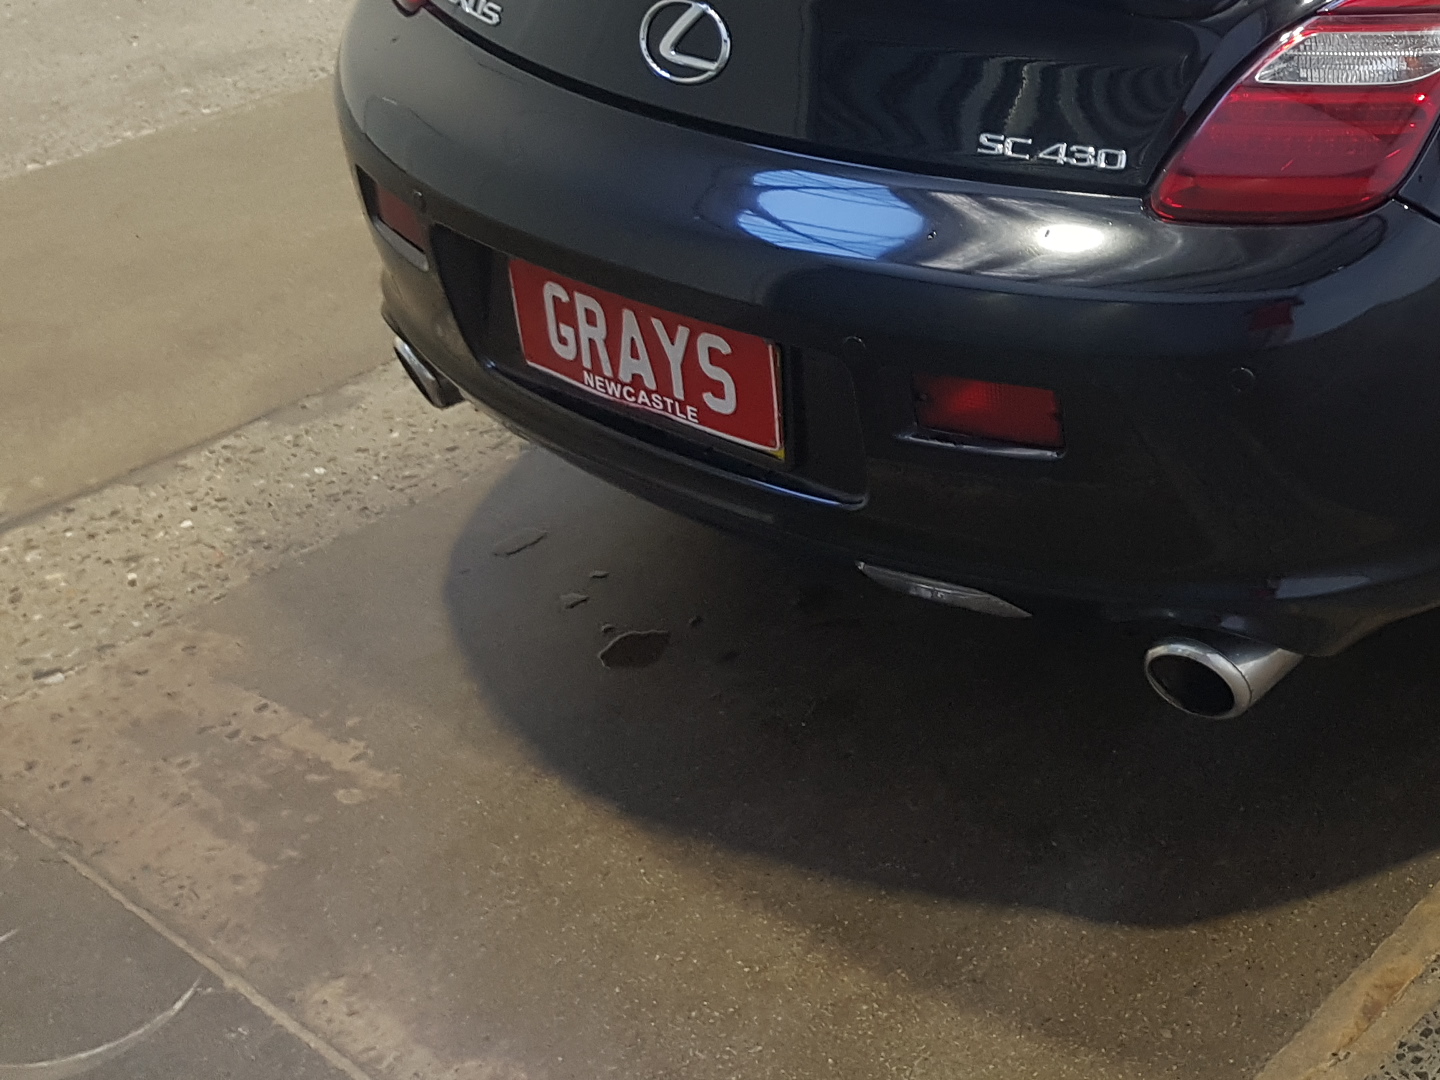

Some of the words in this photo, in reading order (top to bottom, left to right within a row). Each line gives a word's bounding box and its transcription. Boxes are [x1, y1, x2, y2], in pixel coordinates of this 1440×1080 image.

[977, 132, 1033, 161] SC
[1037, 142, 1128, 170] 430
[542, 280, 737, 416] GRAYS
[583, 369, 699, 424] NEWCASTLE
